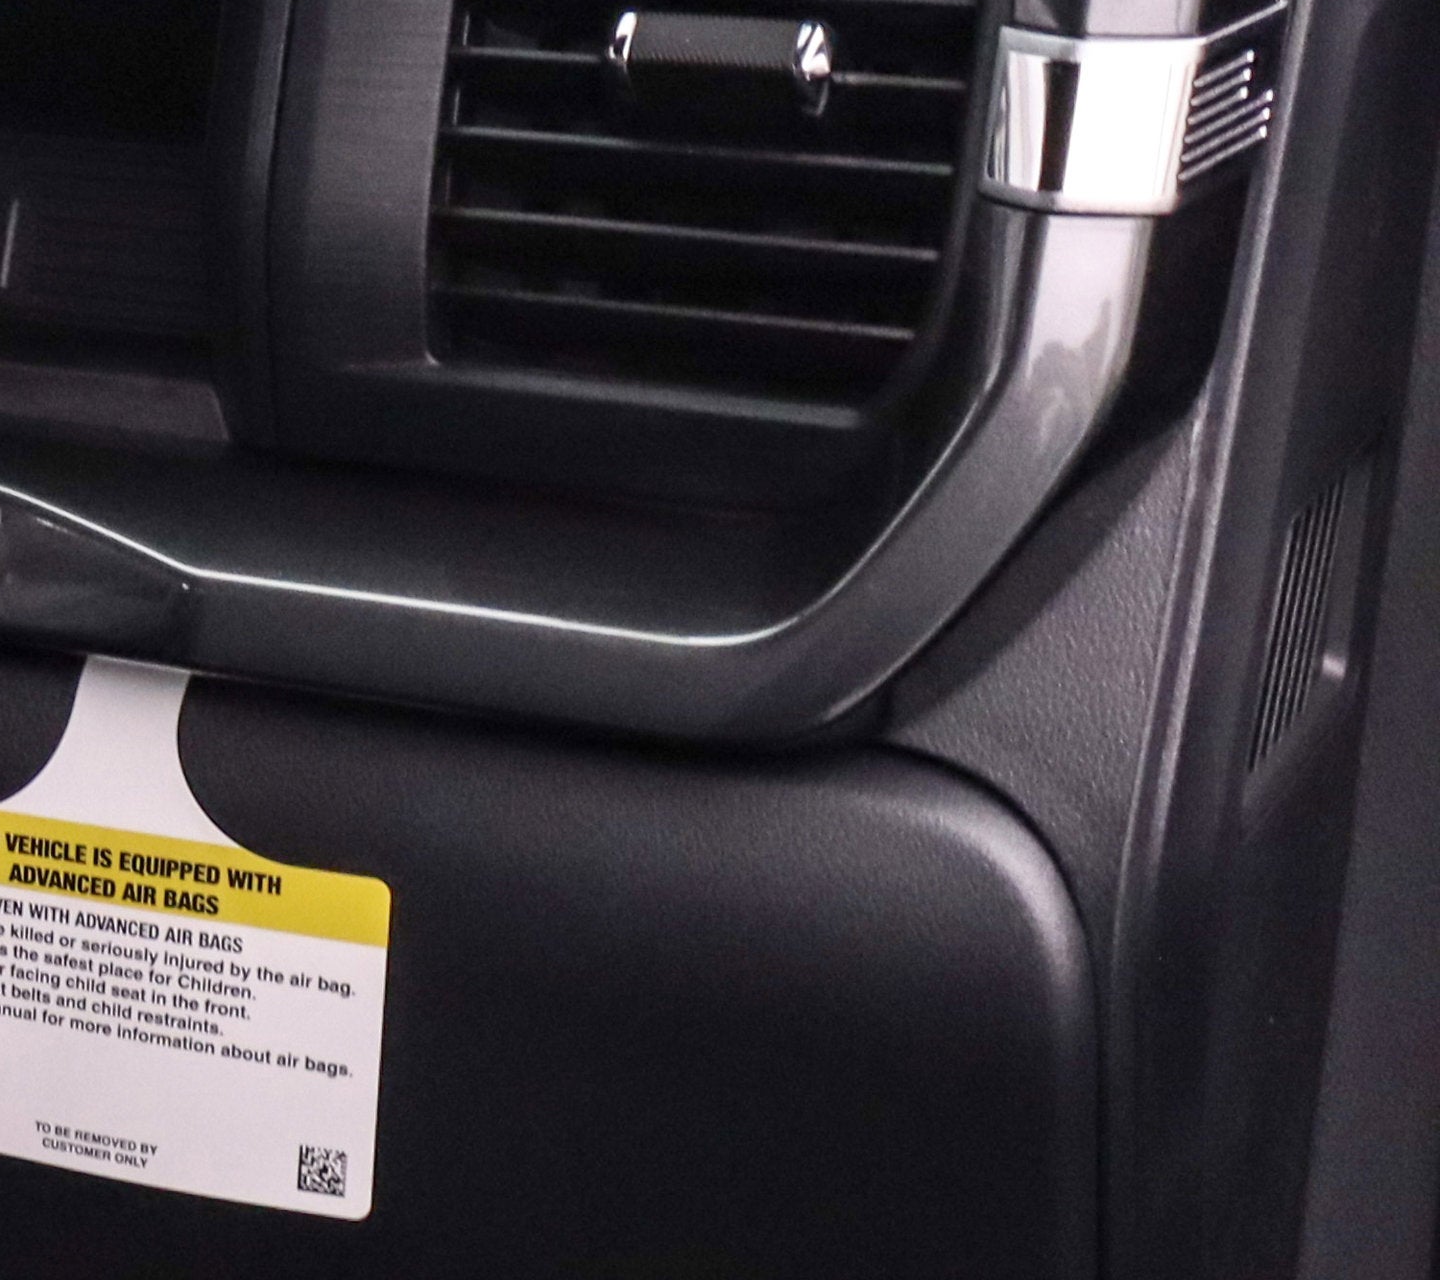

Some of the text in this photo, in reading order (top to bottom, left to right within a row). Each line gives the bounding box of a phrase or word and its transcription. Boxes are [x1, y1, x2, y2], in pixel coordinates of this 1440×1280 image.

[5, 832, 87, 865] VEHICLE
[93, 847, 113, 869] IS
[119, 852, 221, 886] EQUIPPED
[227, 868, 282, 896] WITH
[9, 863, 219, 916] ADVANCED AIR BAGS
[29, 902, 70, 925] WITH
[75, 911, 160, 941] ADVANCED
[165, 927, 193, 946] AIR
[199, 932, 243, 954] BAGS
[11, 924, 55, 945] killed
[59, 936, 76, 949] or
[82, 940, 159, 967] seriously
[164, 951, 225, 975] injured
[230, 962, 251, 983] by
[257, 967, 285, 984] the
[290, 973, 312, 989] air
[318, 976, 355, 999] bag.
[13, 946, 39, 962] the
[44, 954, 93, 973] safest
[99, 962, 143, 981] place
[149, 966, 172, 986] for
[178, 971, 256, 1000] Children.
[10, 964, 61, 990] facing
[66, 976, 106, 995] child
[112, 986, 146, 1003] seat
[152, 989, 167, 1007] in
[173, 994, 199, 1011] the
[205, 999, 250, 1020] front.
[12, 984, 51, 1005] belts
[56, 996, 87, 1011] and
[92, 1001, 132, 1020] child
[138, 1011, 223, 1036] restraints.
[42, 1010, 65, 1027] for
[70, 1018, 112, 1037] more
[117, 1024, 215, 1055] information
[221, 1044, 271, 1065] about
[276, 1053, 299, 1069] air
[305, 1056, 353, 1078] bags.
[36, 1120, 158, 1155] TO BE REMOVED BY
[42, 1137, 148, 1169] CUSTOMER ONLY
